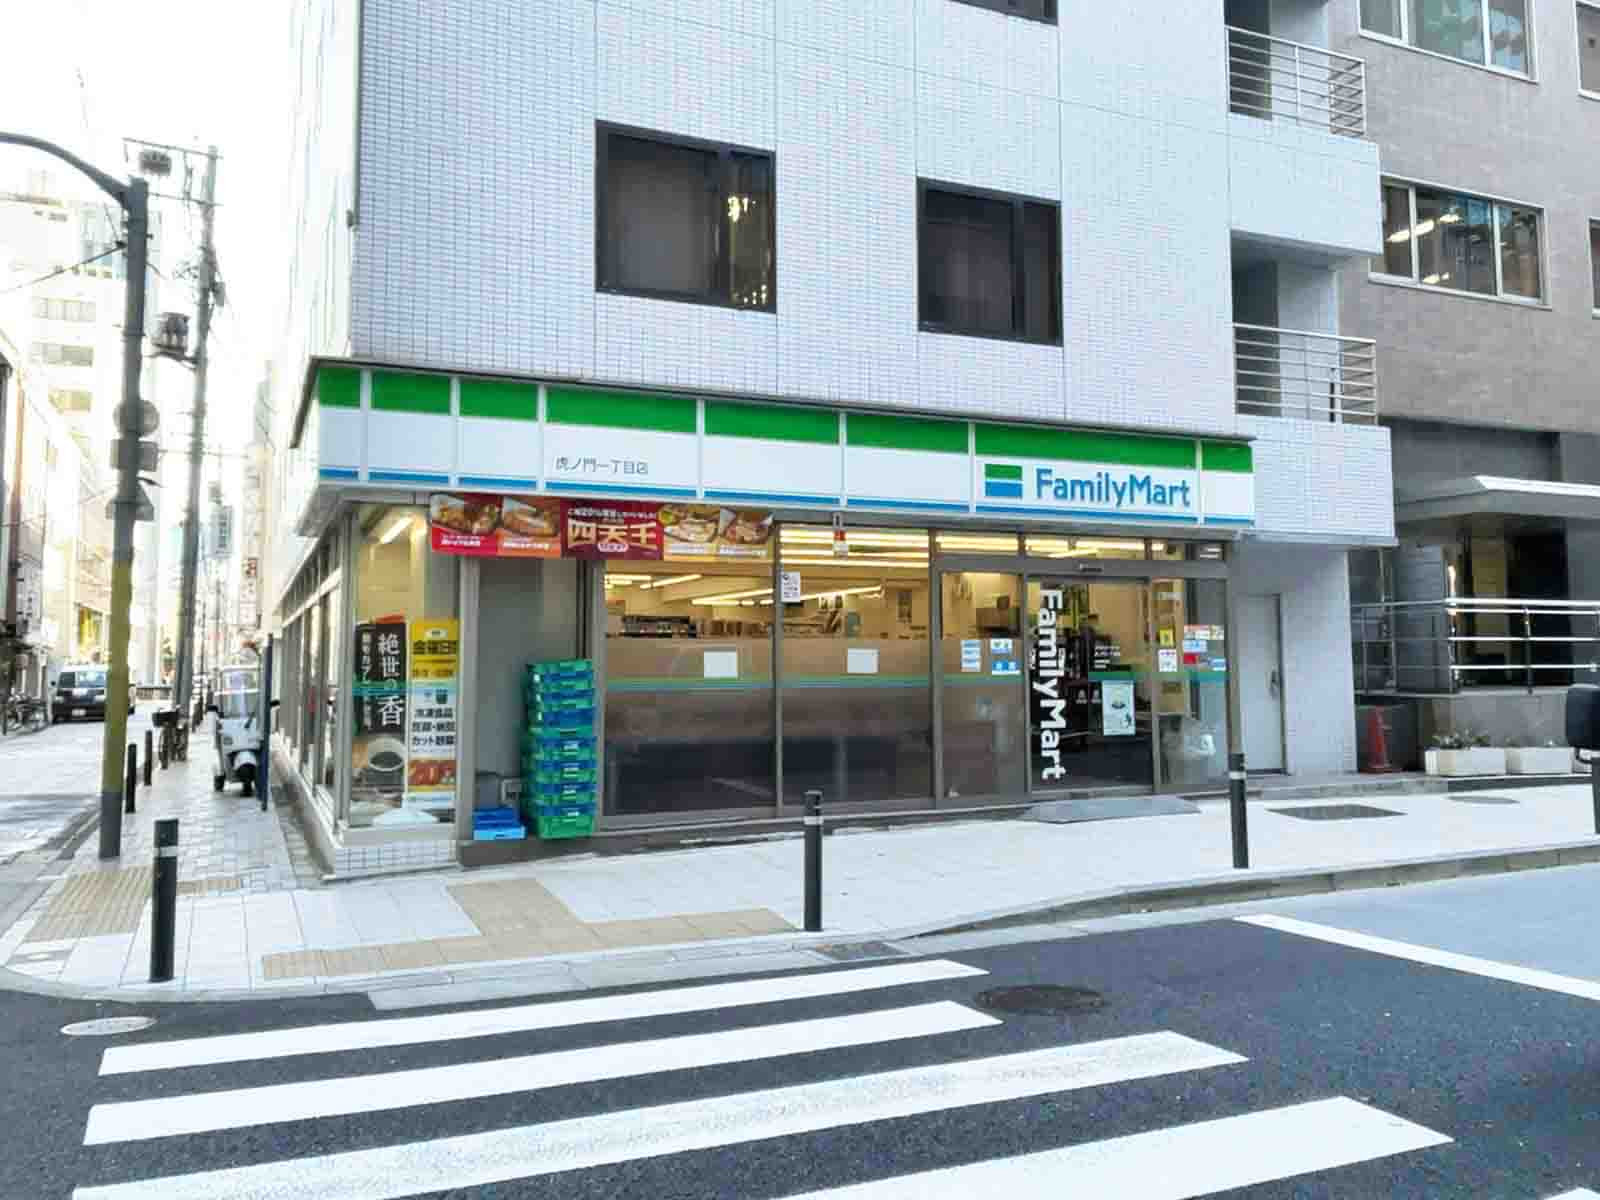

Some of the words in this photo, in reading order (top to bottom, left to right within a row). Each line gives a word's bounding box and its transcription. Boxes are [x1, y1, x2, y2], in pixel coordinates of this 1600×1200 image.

[554, 456, 649, 475] 虎ノ門一丁目店
[1035, 467, 1191, 508] FamilyMart
[567, 517, 657, 549] 四天王
[1032, 588, 1067, 780] FamilyMart
